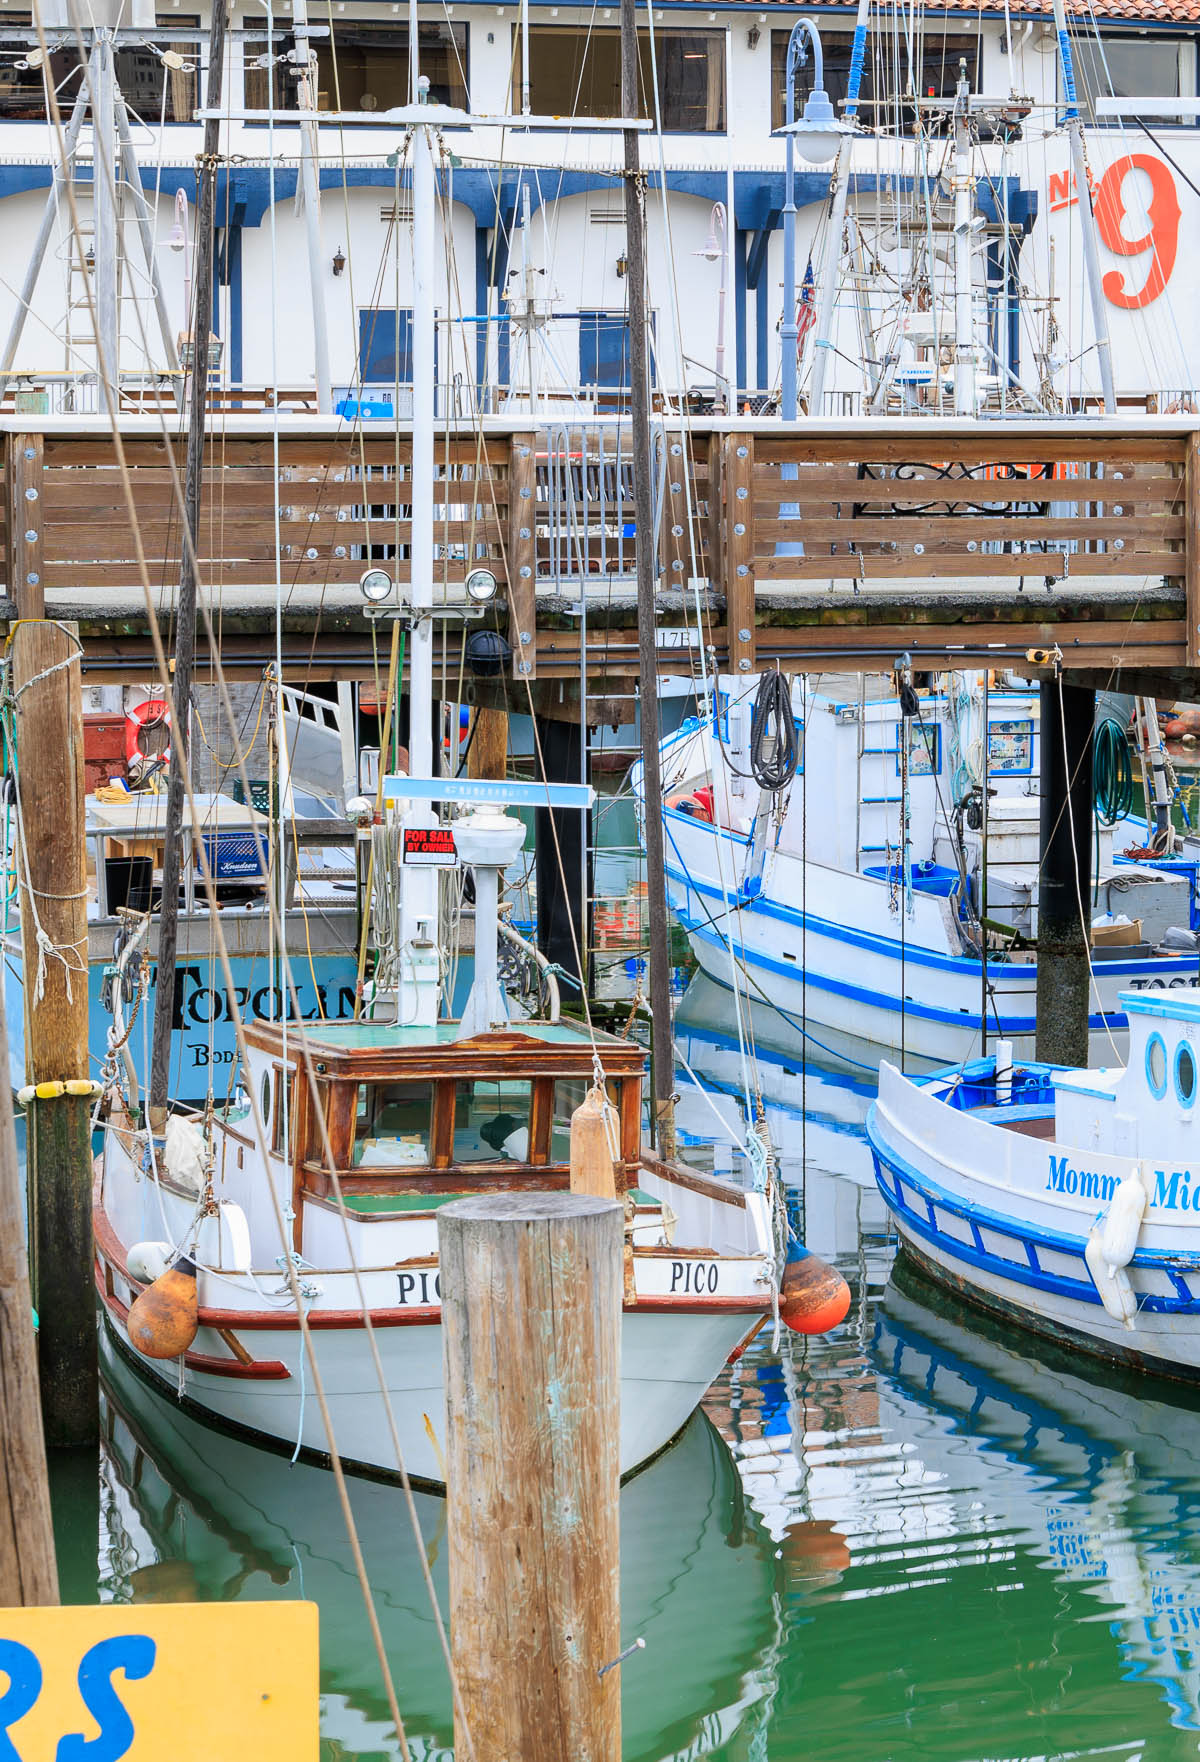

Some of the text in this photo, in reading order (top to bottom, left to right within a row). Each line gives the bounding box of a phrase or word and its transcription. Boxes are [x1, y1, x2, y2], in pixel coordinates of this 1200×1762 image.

[1093, 154, 1182, 309] 9
[405, 830, 427, 843] FOR
[407, 842, 454, 854] BY OWNER
[221, 861, 257, 871] Knudsen
[1046, 1155, 1122, 1202] Momm
[397, 1272, 441, 1304] PI
[670, 1262, 719, 1294] PICO
